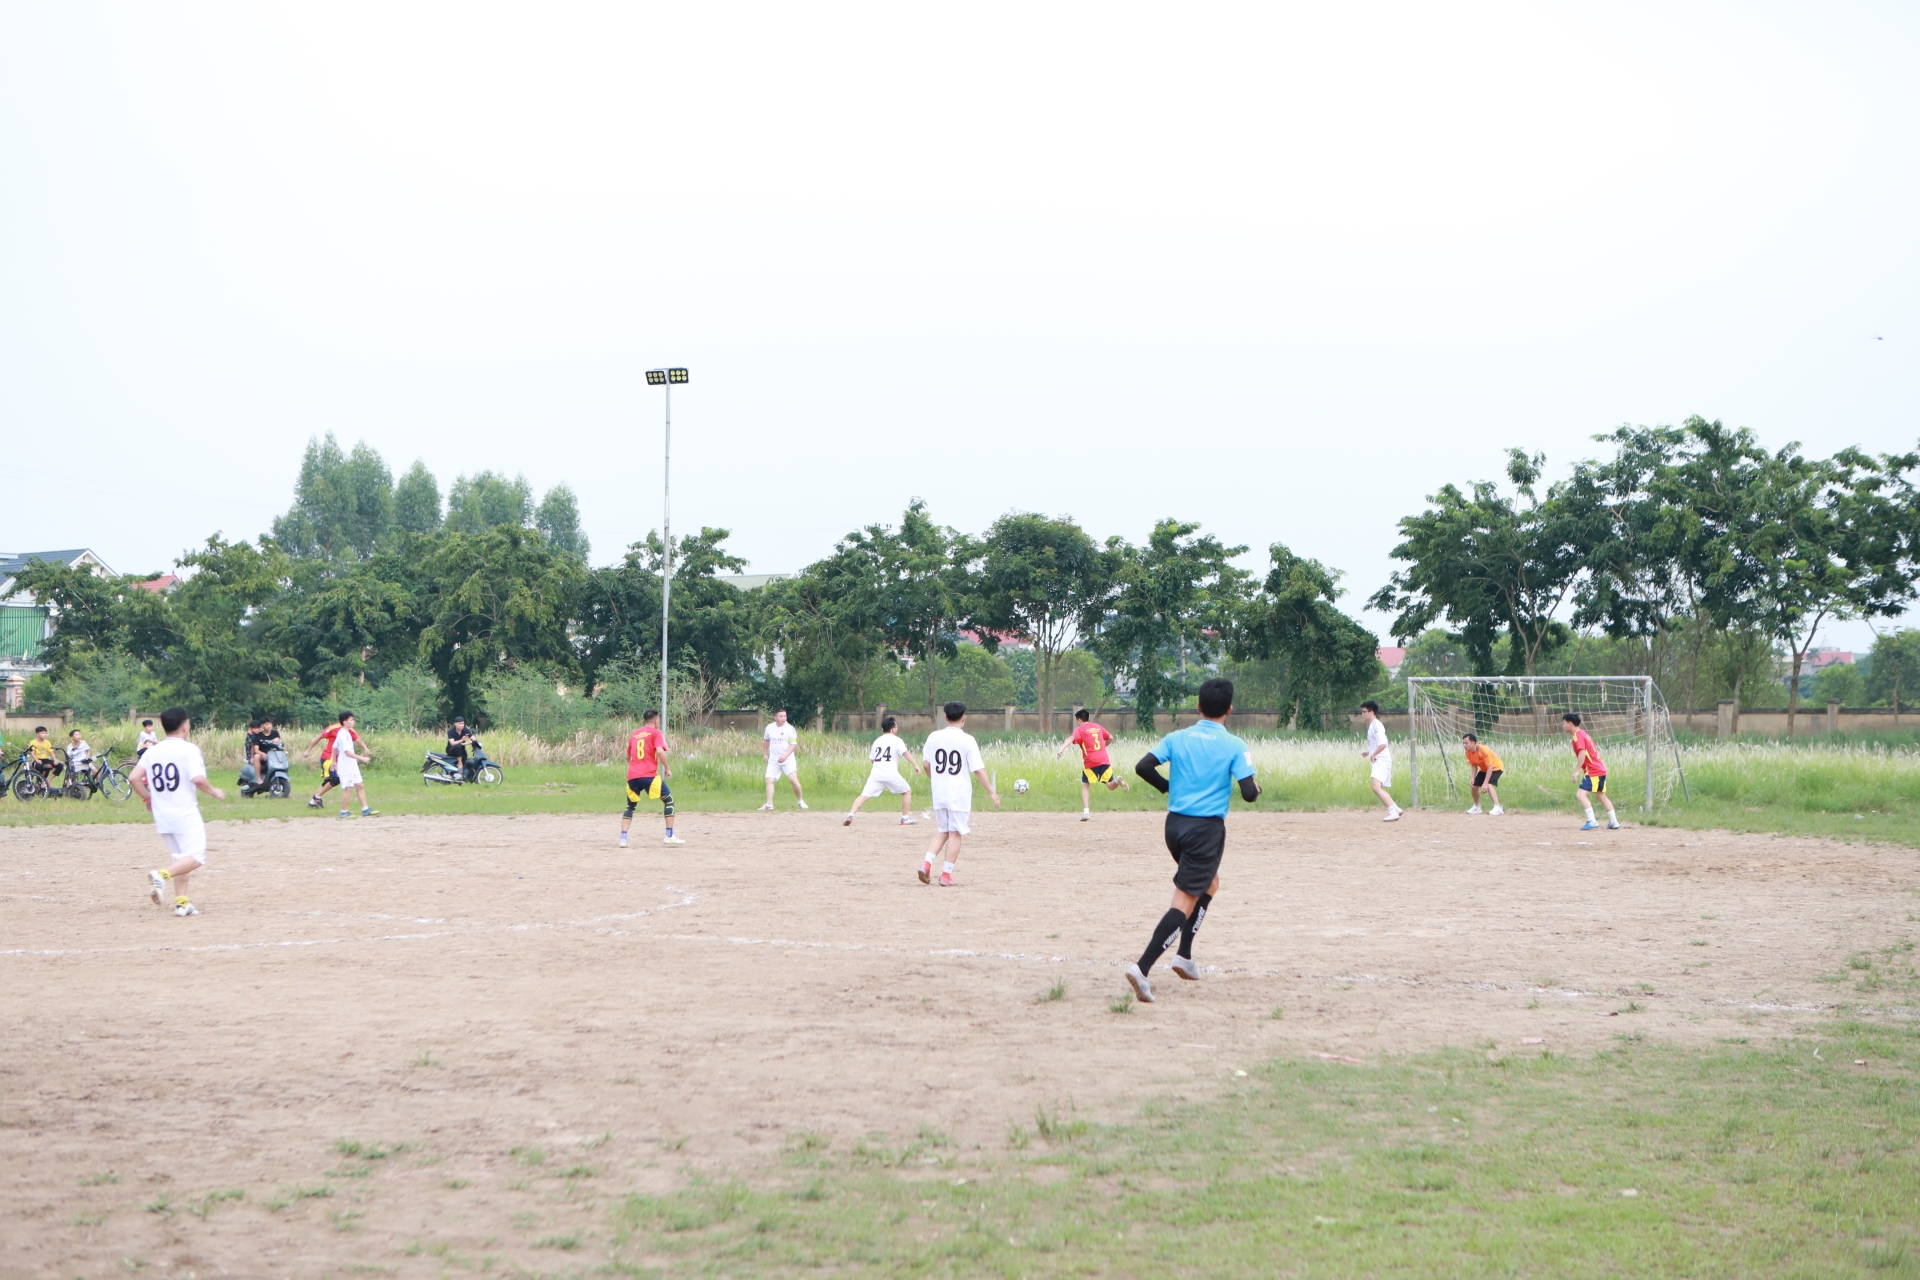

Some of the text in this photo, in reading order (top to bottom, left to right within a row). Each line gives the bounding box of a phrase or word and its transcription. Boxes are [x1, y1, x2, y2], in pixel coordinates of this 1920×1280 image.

[636, 738, 645, 760] 8
[1091, 733, 1101, 751] 3
[874, 746, 892, 762] 24
[935, 748, 962, 775] 99
[151, 762, 180, 792] 89
